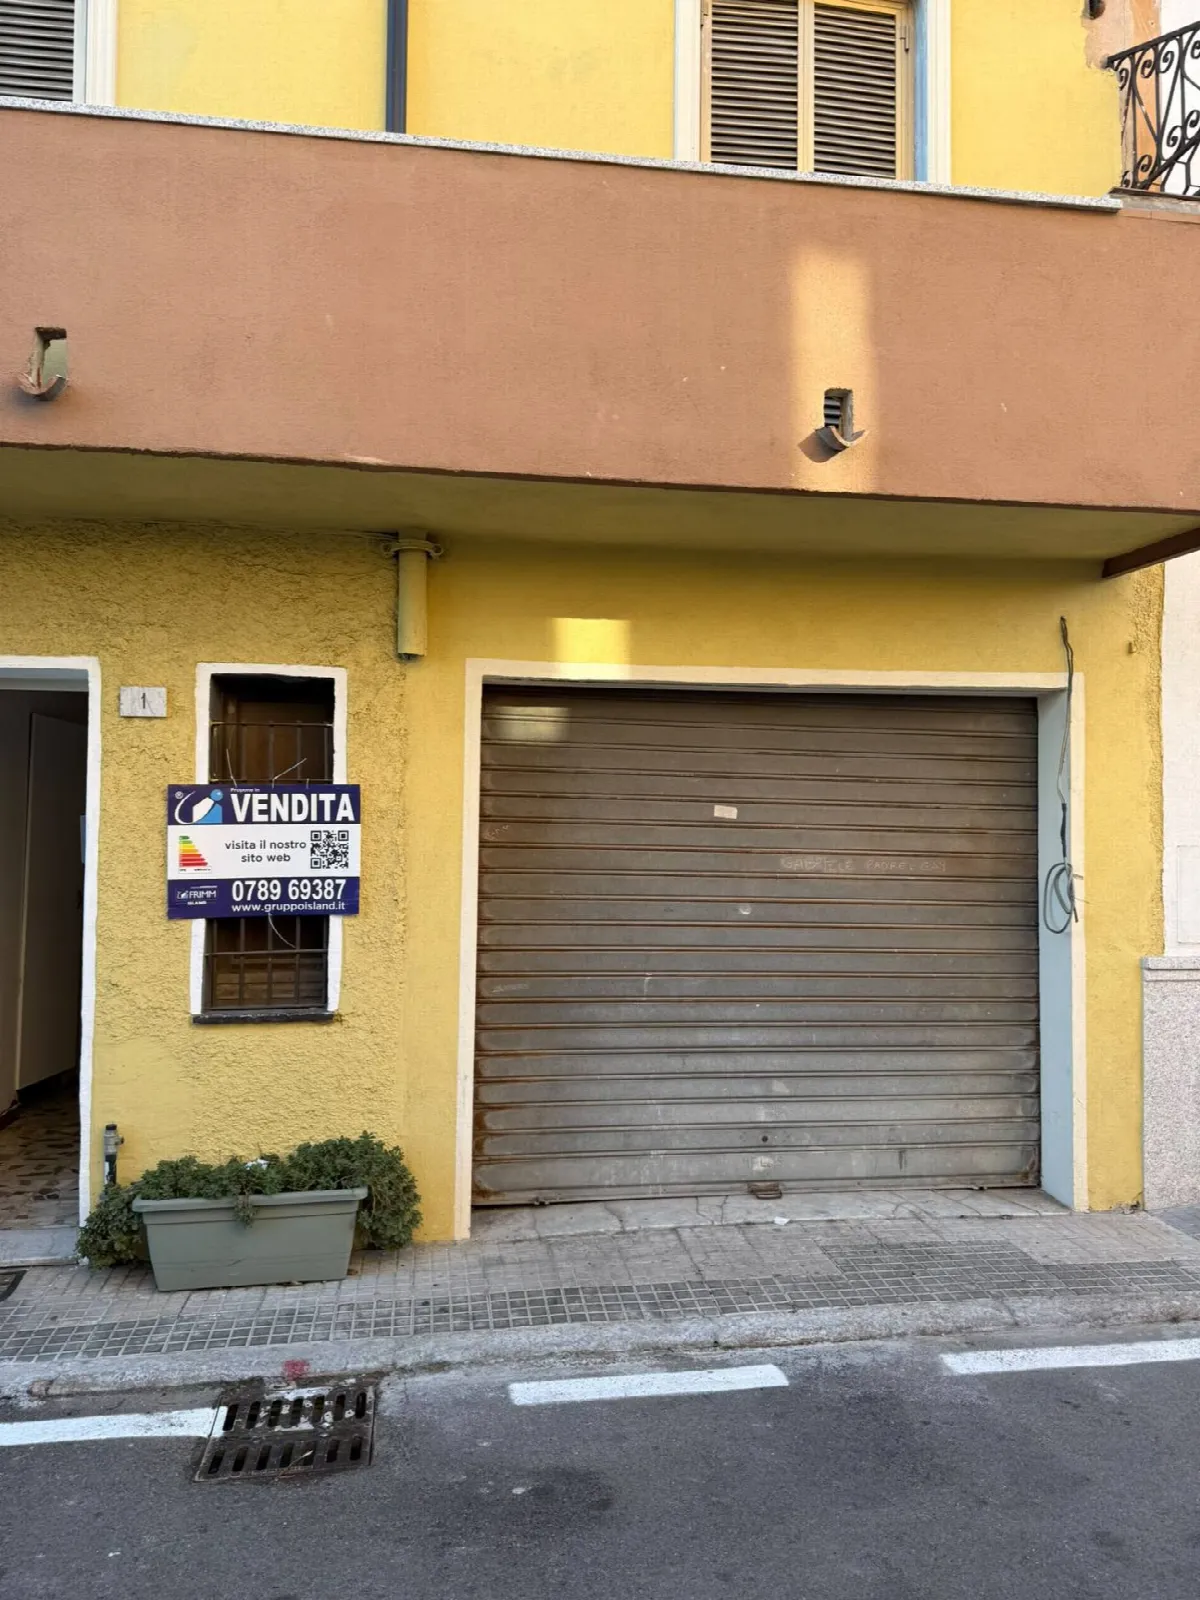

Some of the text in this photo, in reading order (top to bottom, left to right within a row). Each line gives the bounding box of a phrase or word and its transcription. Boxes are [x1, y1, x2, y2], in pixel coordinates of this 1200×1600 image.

[141, 692, 146, 709] 1
[230, 793, 355, 822] VENDITA
[225, 840, 306, 850] visita il nostro
[241, 853, 291, 863] sito web
[189, 890, 217, 899] FRIMM
[232, 878, 347, 902] 0789 69387
[232, 901, 346, 914] www.gruppoisland.it
